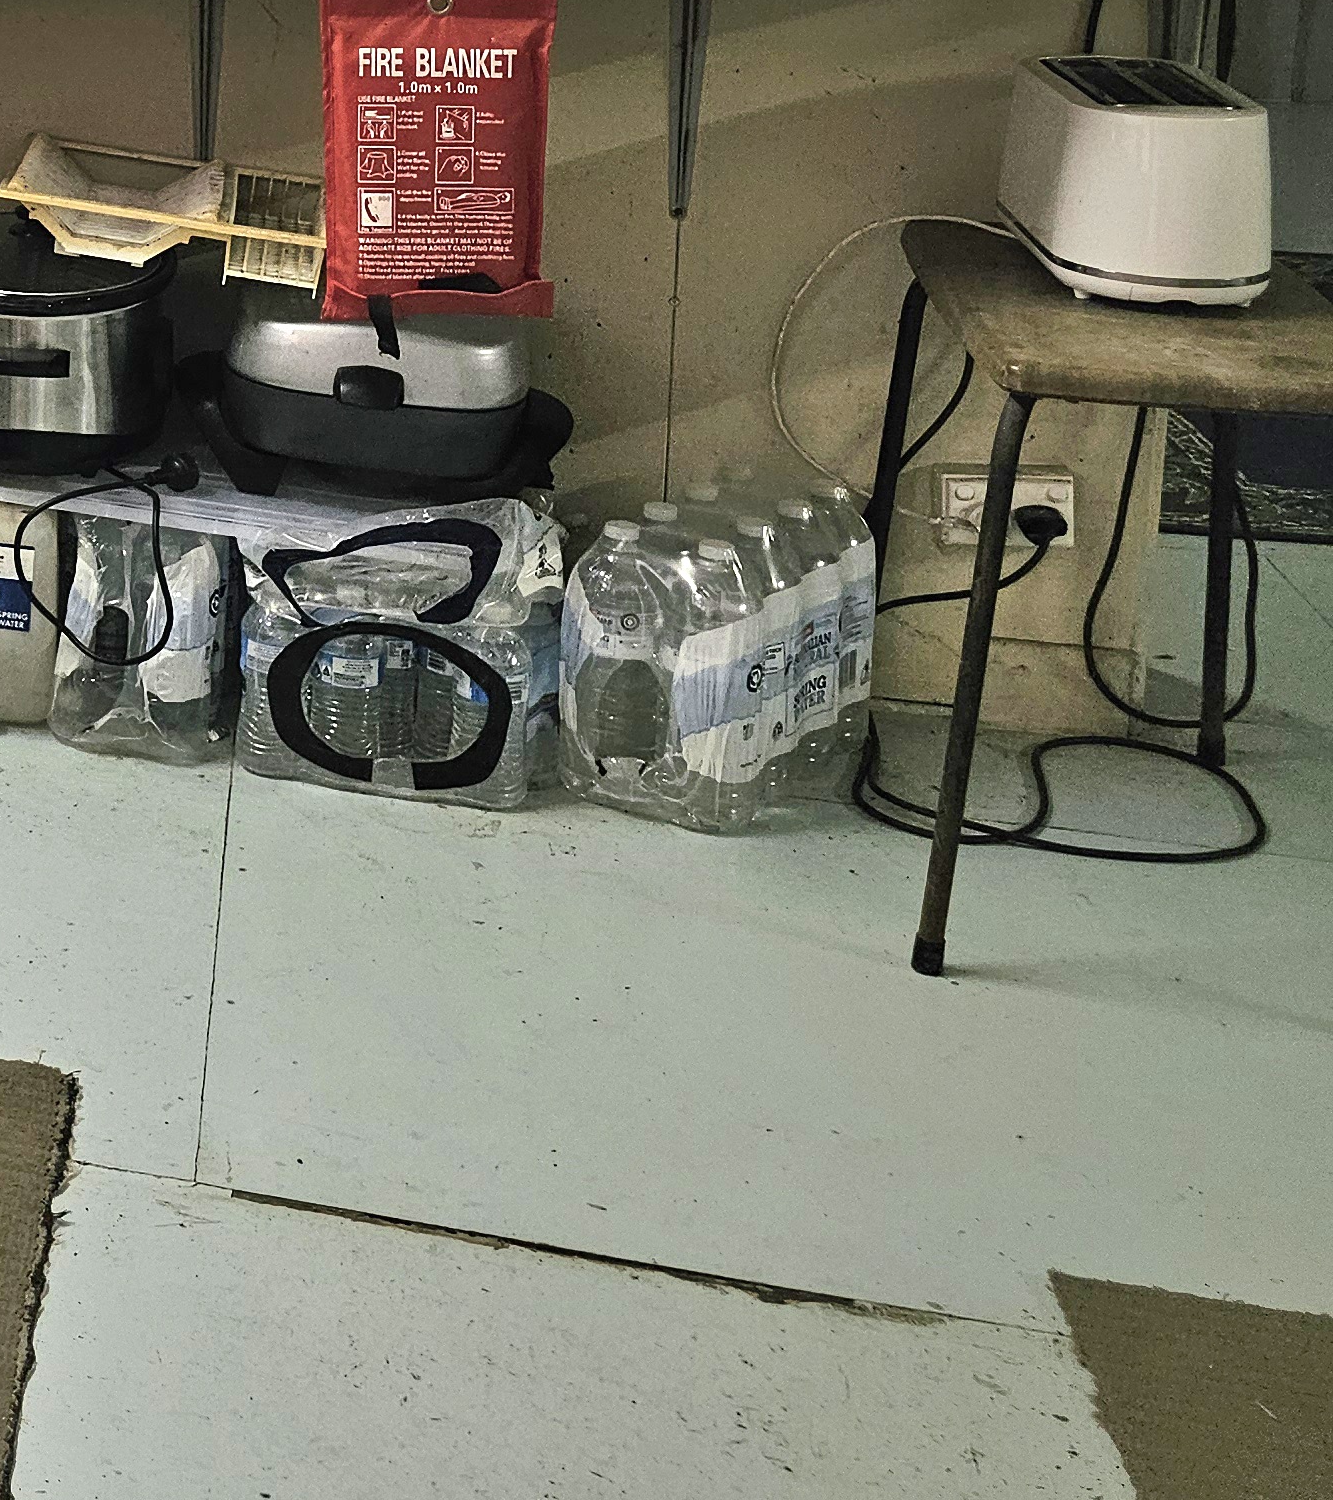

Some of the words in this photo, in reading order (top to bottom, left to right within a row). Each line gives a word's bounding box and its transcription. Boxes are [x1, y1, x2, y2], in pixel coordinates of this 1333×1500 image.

[358, 47, 404, 77] FIRE
[415, 47, 518, 78] BLANKET
[398, 81, 431, 94] 1.0m
[434, 85, 442, 93] x
[445, 82, 478, 94] 1.0m
[372, 95, 386, 103] FIRE
[386, 95, 416, 103] BLANKET
